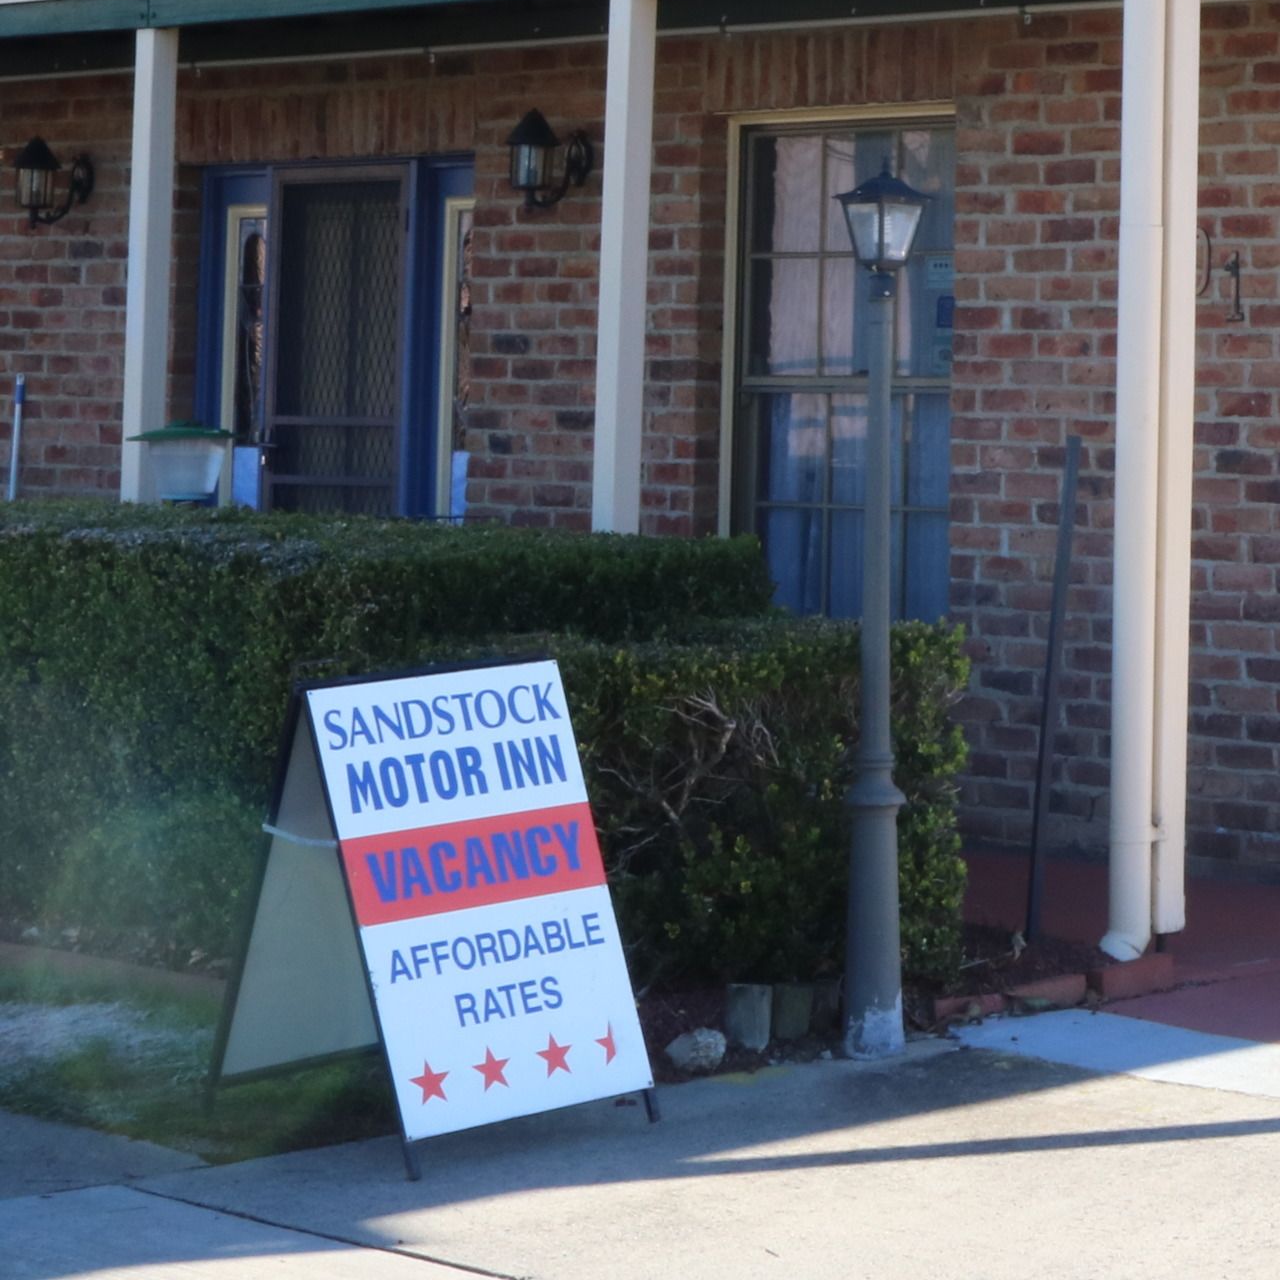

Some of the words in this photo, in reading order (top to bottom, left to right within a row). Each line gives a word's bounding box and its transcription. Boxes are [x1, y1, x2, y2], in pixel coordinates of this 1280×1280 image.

[323, 682, 562, 751] SANDSTOCK
[345, 746, 489, 815] MOTOR
[494, 734, 568, 791] INN
[366, 821, 581, 904] VACANCY
[390, 913, 605, 985] AFFORDABLE
[455, 976, 563, 1028] RATES
